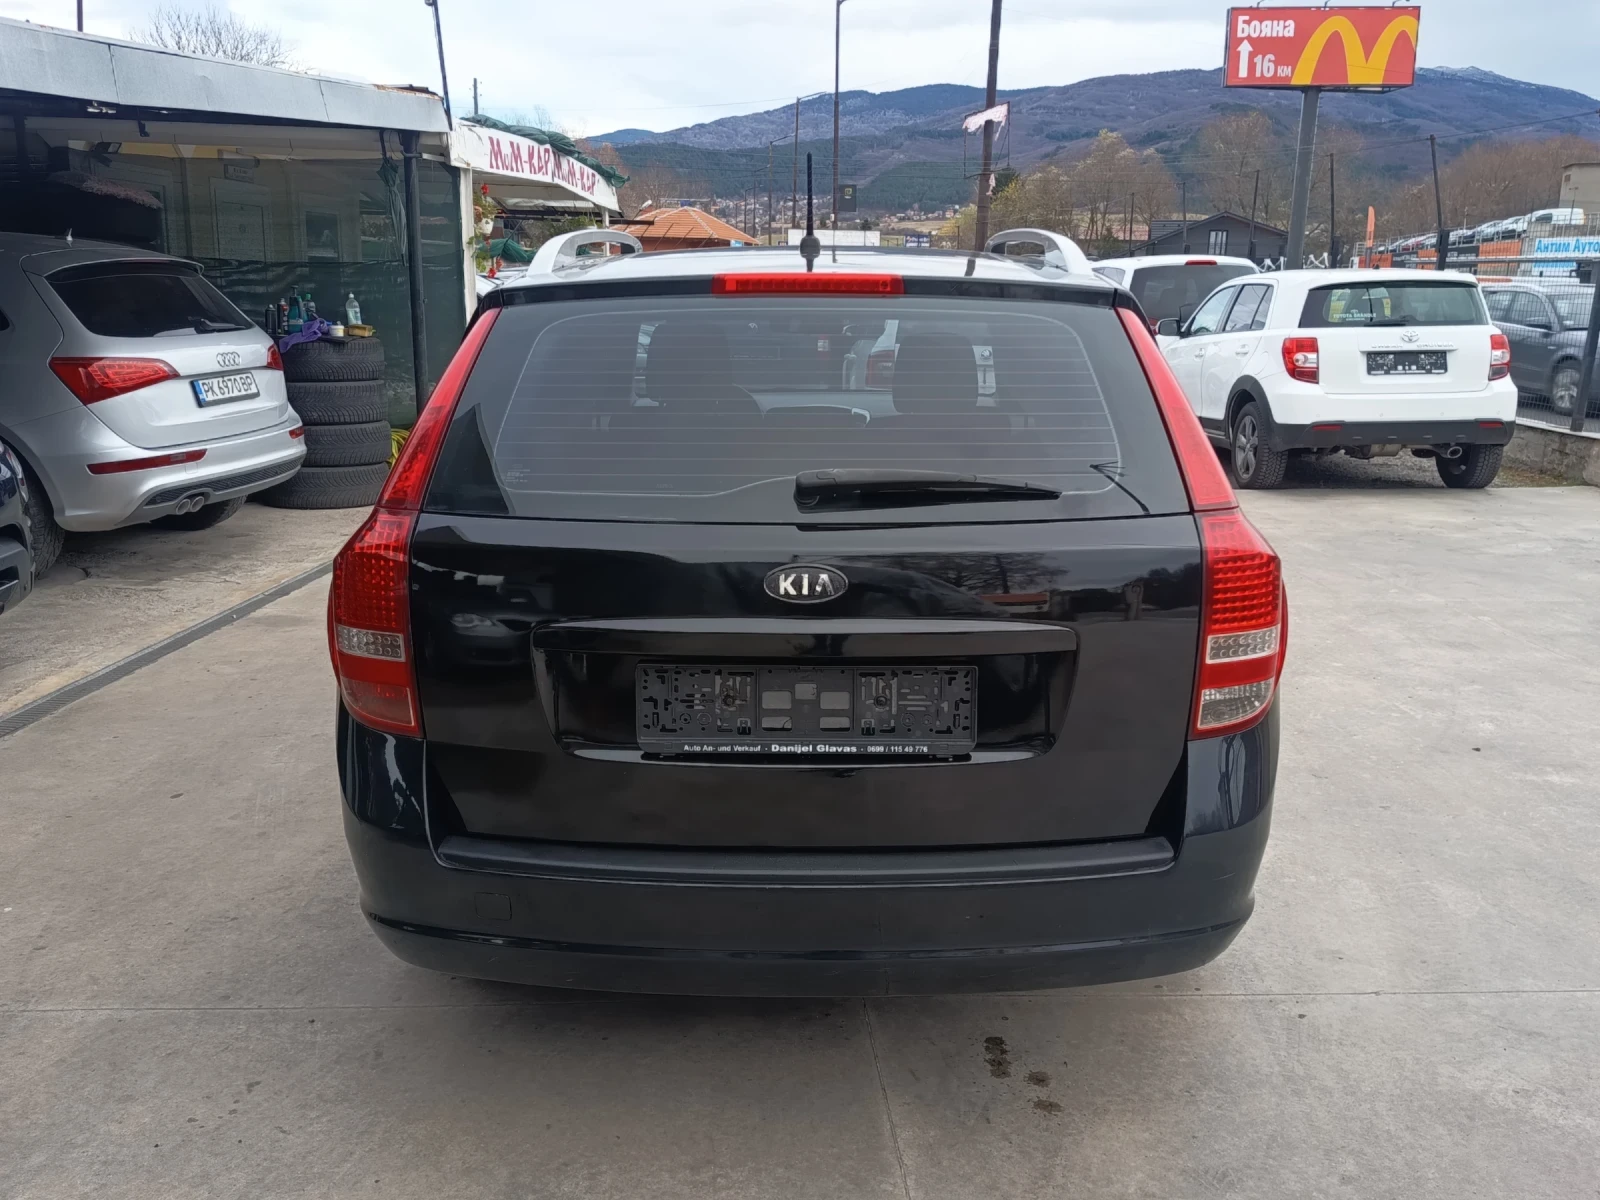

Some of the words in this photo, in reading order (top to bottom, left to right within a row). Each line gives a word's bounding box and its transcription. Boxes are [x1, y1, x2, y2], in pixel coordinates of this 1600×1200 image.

[1237, 15, 1295, 38] Бояна
[1253, 54, 1275, 77] 16
[202, 381, 218, 398] PK
[218, 378, 241, 395] 6970
[240, 376, 252, 391] BP
[777, 573, 835, 596] KIA
[683, 744, 701, 752] Auto
[702, 744, 716, 752] An-
[717, 744, 732, 752] und
[733, 744, 761, 752] Verkauf
[771, 744, 813, 754] Danijel
[816, 744, 857, 753] Glavas
[867, 745, 885, 753] 0699
[891, 745, 903, 753] 115
[915, 745, 928, 753] 776
